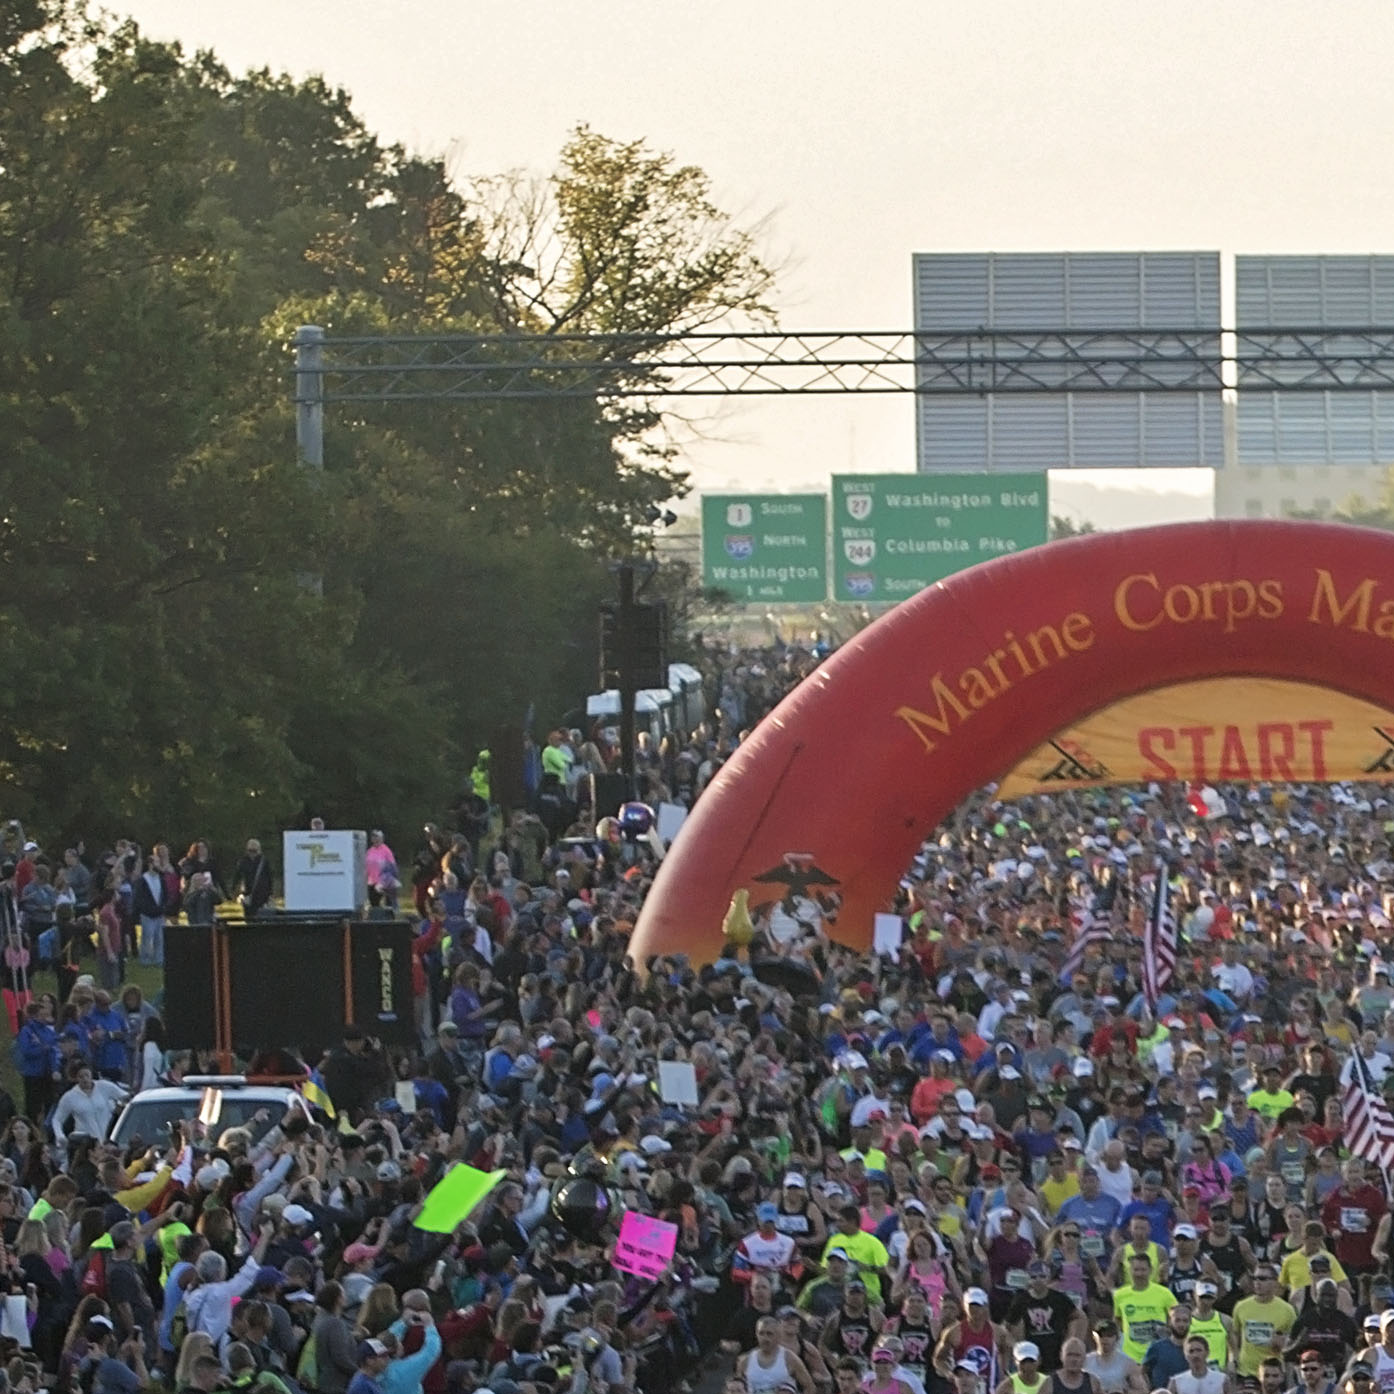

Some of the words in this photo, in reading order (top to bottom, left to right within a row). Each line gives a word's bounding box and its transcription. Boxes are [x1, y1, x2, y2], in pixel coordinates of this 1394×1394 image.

[842, 482, 875, 493] WEST
[852, 499, 868, 514] 27
[886, 493, 992, 510] Washington
[1000, 491, 1039, 508] Blvd
[761, 502, 803, 515] SOUTH
[841, 526, 875, 538] WEST
[763, 534, 807, 547] NORTH
[886, 538, 970, 553] Columbia
[979, 537, 1018, 552] Pike
[711, 564, 819, 583] Washington
[894, 607, 1096, 752] Marine
[1113, 571, 1283, 634] Corps
[1138, 719, 1333, 781] START
